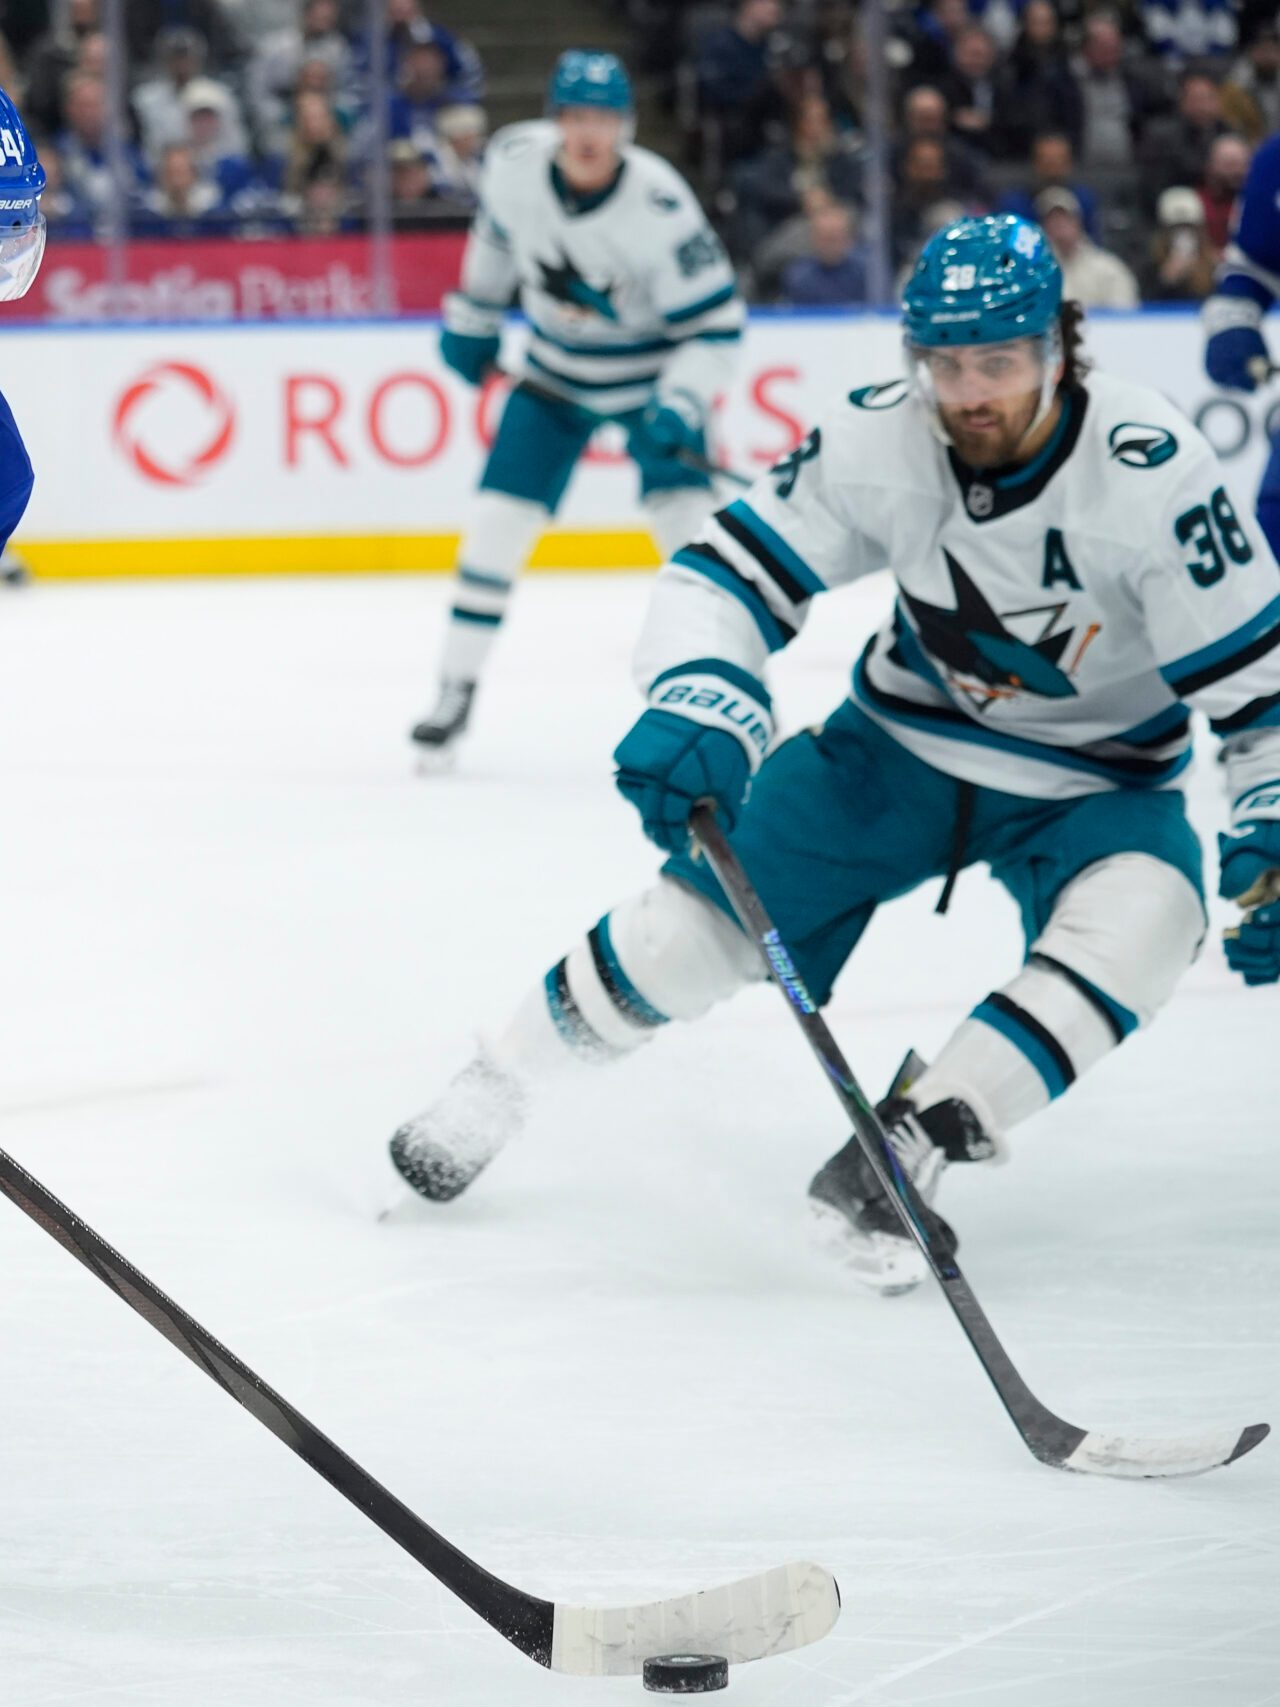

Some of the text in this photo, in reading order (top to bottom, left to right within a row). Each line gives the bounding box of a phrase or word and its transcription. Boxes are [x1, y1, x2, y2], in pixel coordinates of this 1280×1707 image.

[282, 366, 807, 470] ROS
[1042, 528, 1084, 591] A
[1175, 485, 1253, 588] 38
[659, 685, 769, 753] BAUE
